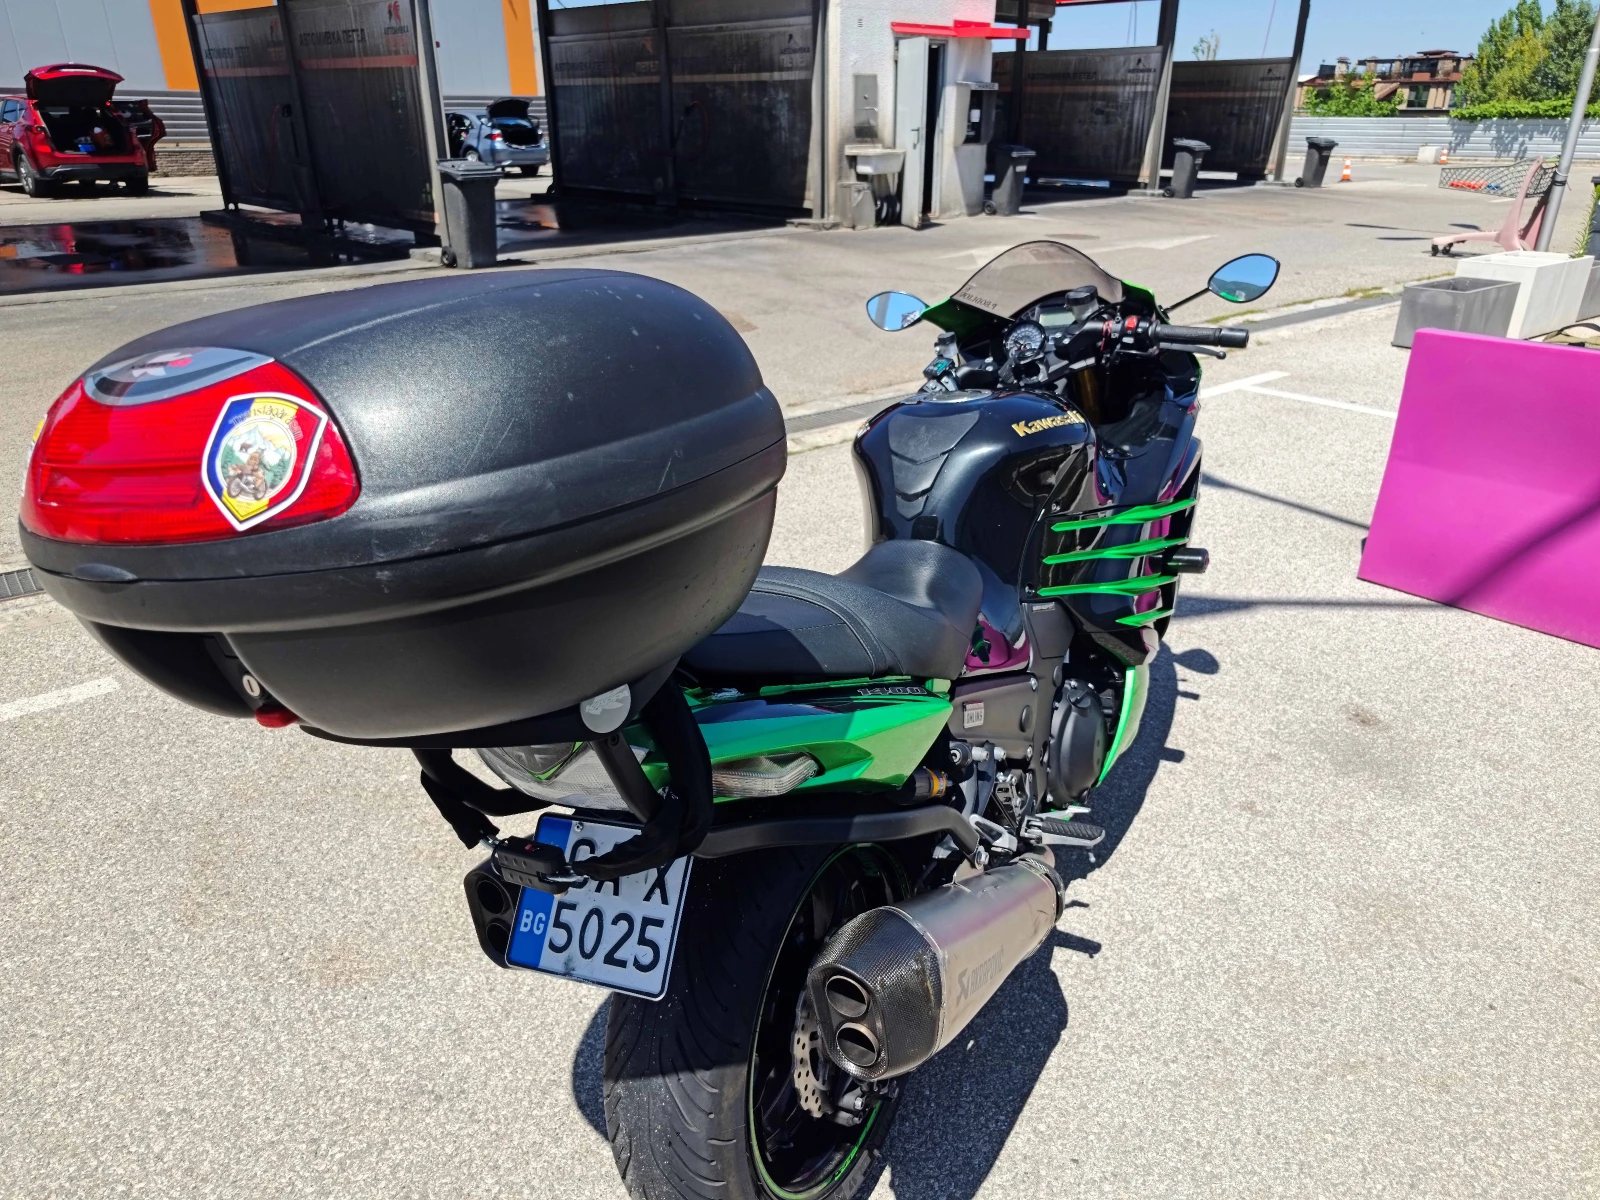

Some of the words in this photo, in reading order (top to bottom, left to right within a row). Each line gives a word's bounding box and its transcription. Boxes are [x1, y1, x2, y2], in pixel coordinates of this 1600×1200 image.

[1011, 410, 1086, 437] Kawasaki
[857, 686, 928, 696] 1400
[519, 909, 547, 936] BG
[548, 899, 665, 973] 5025
